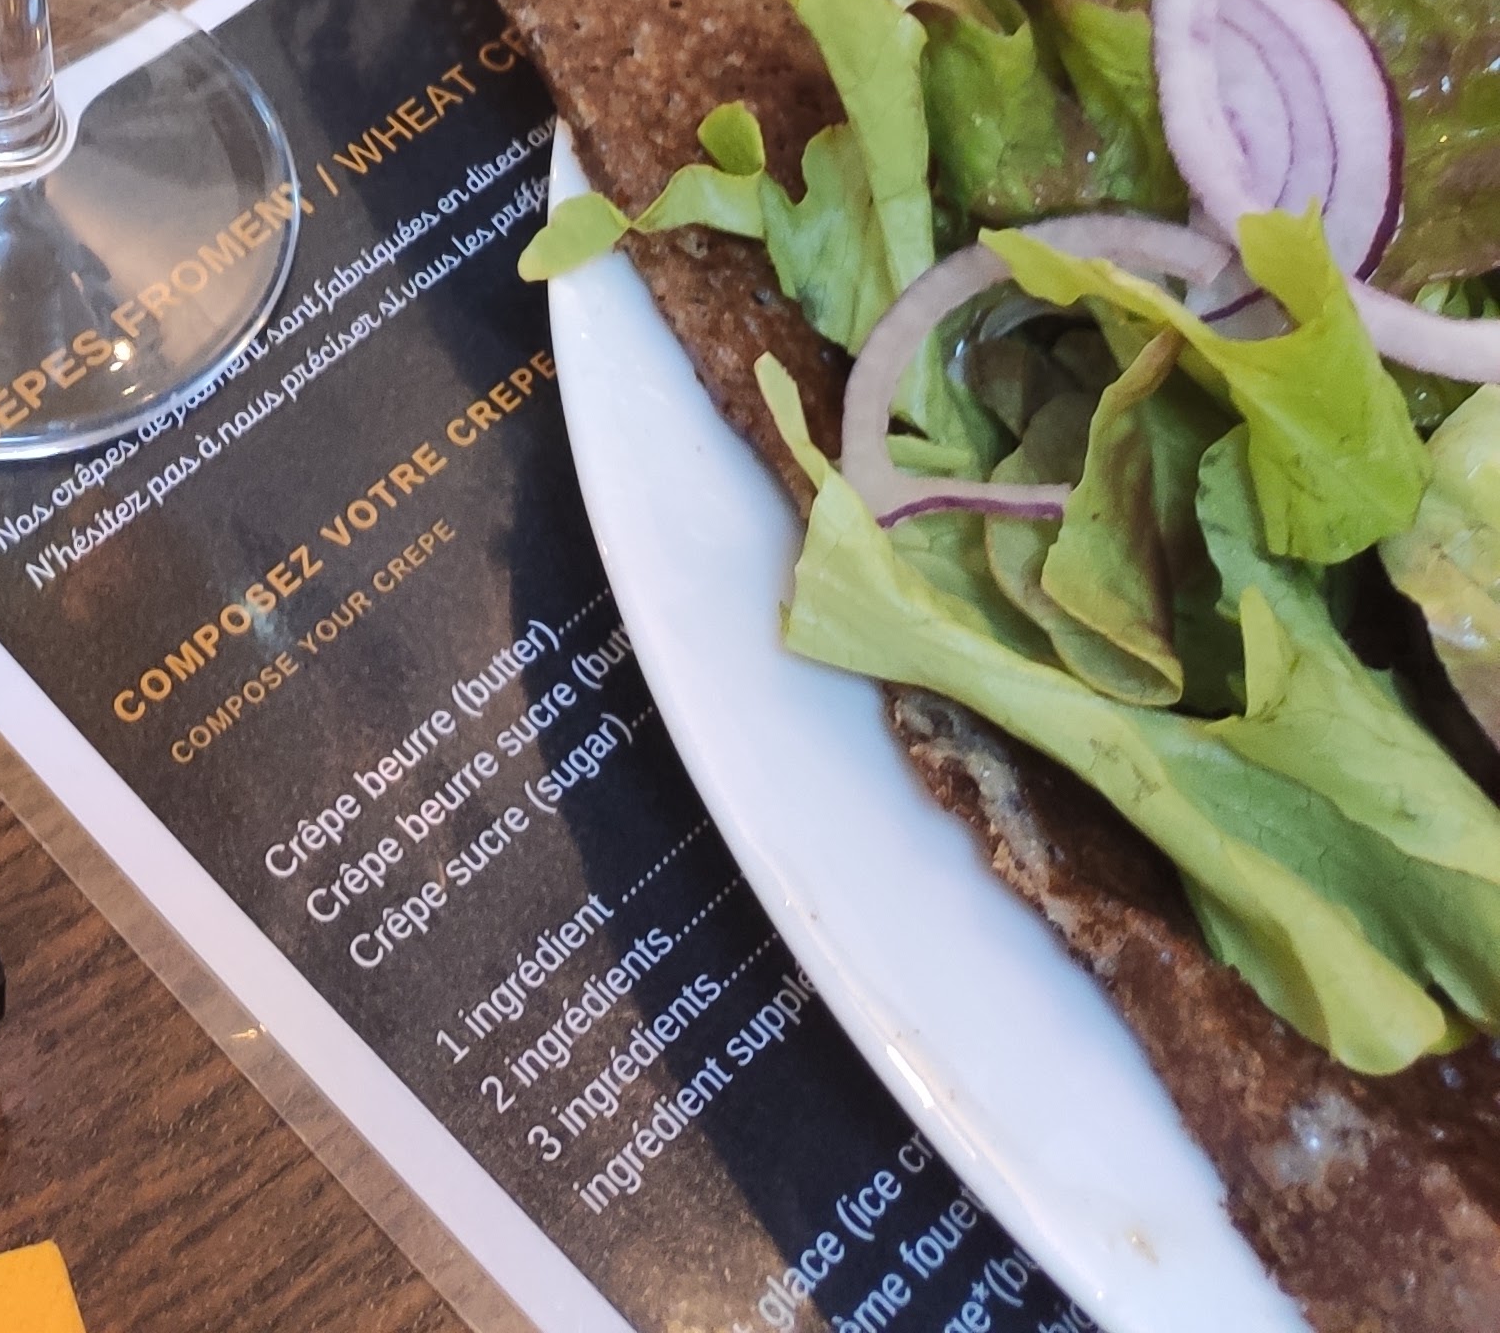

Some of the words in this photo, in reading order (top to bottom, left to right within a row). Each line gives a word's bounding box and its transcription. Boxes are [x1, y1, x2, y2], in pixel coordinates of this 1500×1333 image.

[50, 437, 141, 507] crêpes
[266, 293, 324, 346] sont
[313, 208, 441, 313] fabriquées
[437, 183, 471, 215] en
[465, 137, 530, 195] direct
[109, 180, 316, 339] FROMENT
[332, 63, 477, 177] WHEAT
[24, 488, 154, 590] N'hésitez
[146, 454, 202, 507] pas
[194, 433, 222, 461] à
[217, 389, 285, 446] nous
[280, 311, 383, 404] préciser
[378, 286, 408, 318] si
[400, 251, 463, 300] vous
[451, 228, 497, 257] les
[112, 543, 324, 724] COMPOSEZ
[319, 441, 450, 548] VOTRE
[445, 349, 557, 448] CREPE
[170, 651, 300, 763] COMPOSE
[296, 589, 372, 656] YOUR
[372, 517, 457, 594] CREPE
[264, 793, 362, 879] Crêpe
[352, 708, 457, 801] beurre
[450, 619, 561, 717] (butter)
[305, 836, 404, 924] Crêpe
[394, 749, 500, 844] beurre
[496, 681, 577, 757] sucre
[349, 879, 448, 969] Crêpe
[444, 805, 531, 887] sucre
[523, 712, 635, 815] (sugar)
[435, 1028, 472, 1066] 1
[457, 892, 615, 1041] ingrédient
[480, 1074, 518, 1115] 2
[503, 925, 675, 1090] ingrédients
[527, 1124, 563, 1163] 3
[550, 972, 723, 1139] ingrédients
[572, 1055, 734, 1216] ingrédient
[756, 1230, 846, 1331] glace
[835, 1168, 903, 1243] (ice
